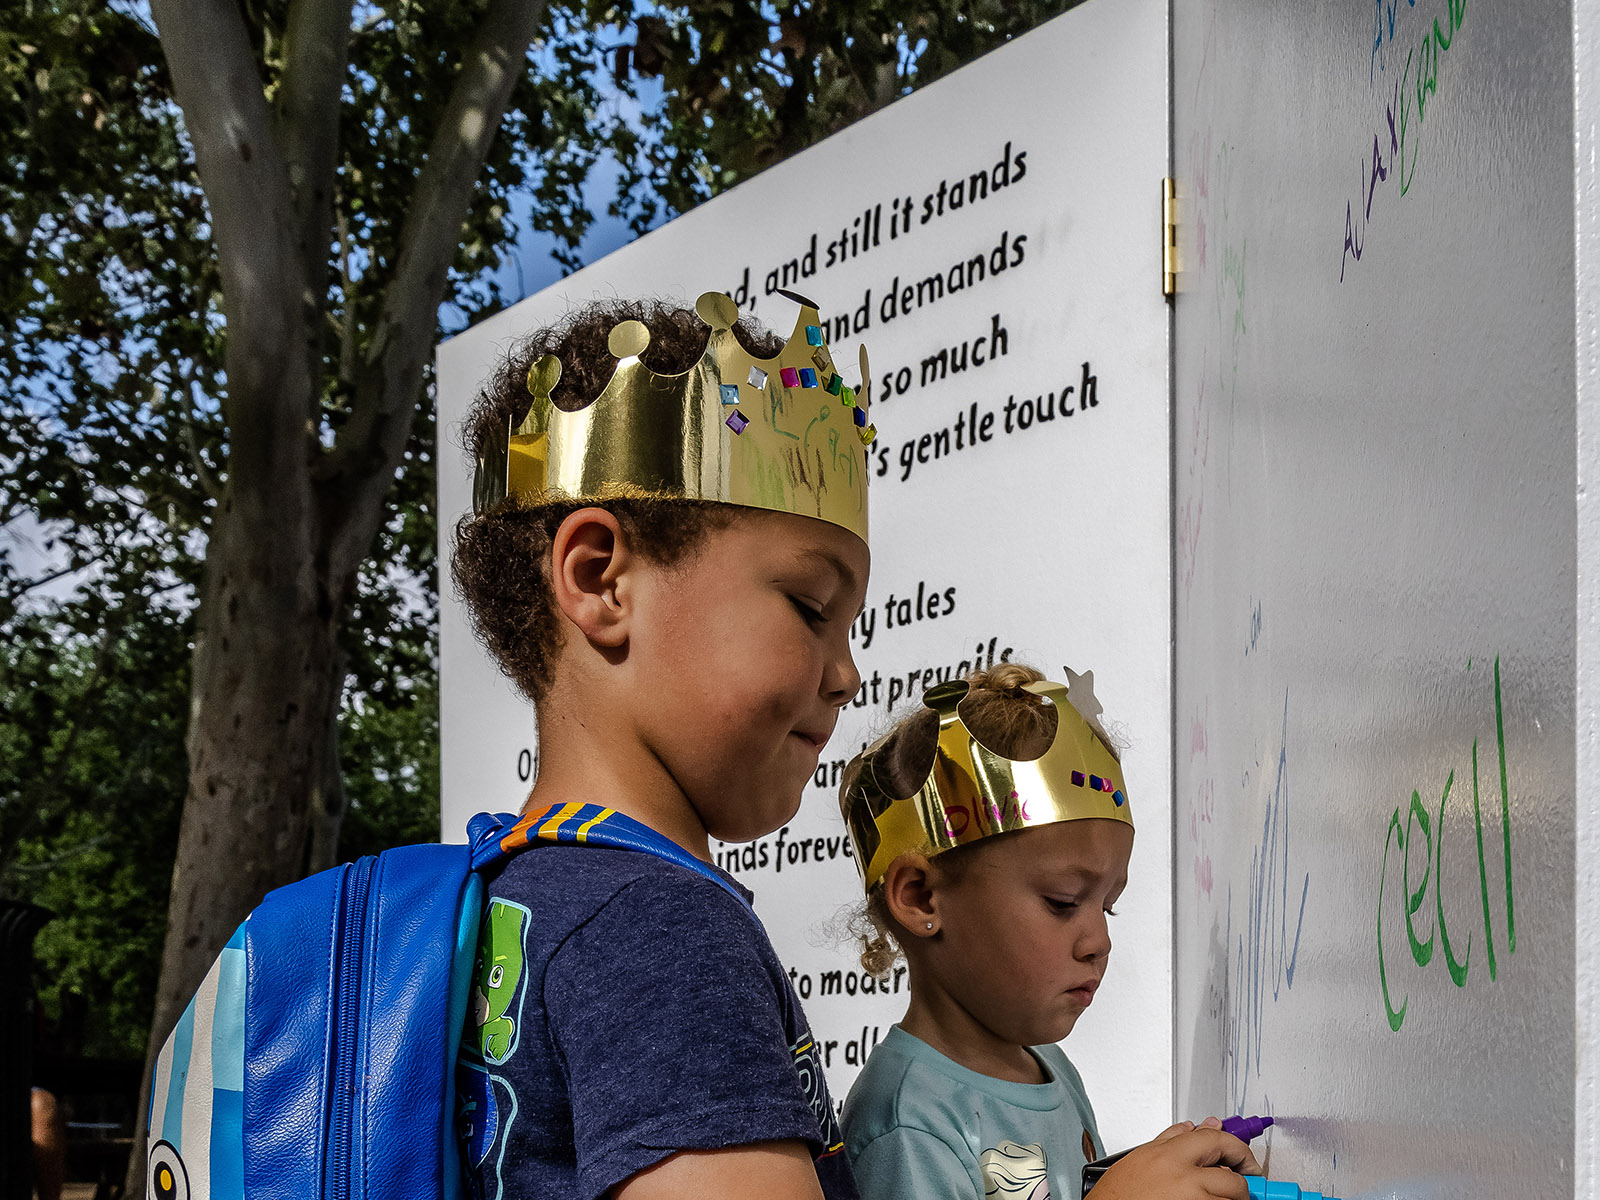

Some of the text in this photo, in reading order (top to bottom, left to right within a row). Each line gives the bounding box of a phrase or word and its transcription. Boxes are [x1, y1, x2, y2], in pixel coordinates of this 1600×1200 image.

[765, 233, 818, 296] and
[825, 203, 882, 269] still
[890, 196, 914, 242] it
[920, 140, 1028, 226] stands
[879, 230, 1028, 325] demands
[879, 366, 912, 404] so
[920, 313, 1009, 388] much
[899, 401, 995, 483] gentle
[1003, 361, 1100, 435] touch
[884, 580, 956, 630] tales
[814, 742, 867, 789] an
[711, 840, 769, 872] inds
